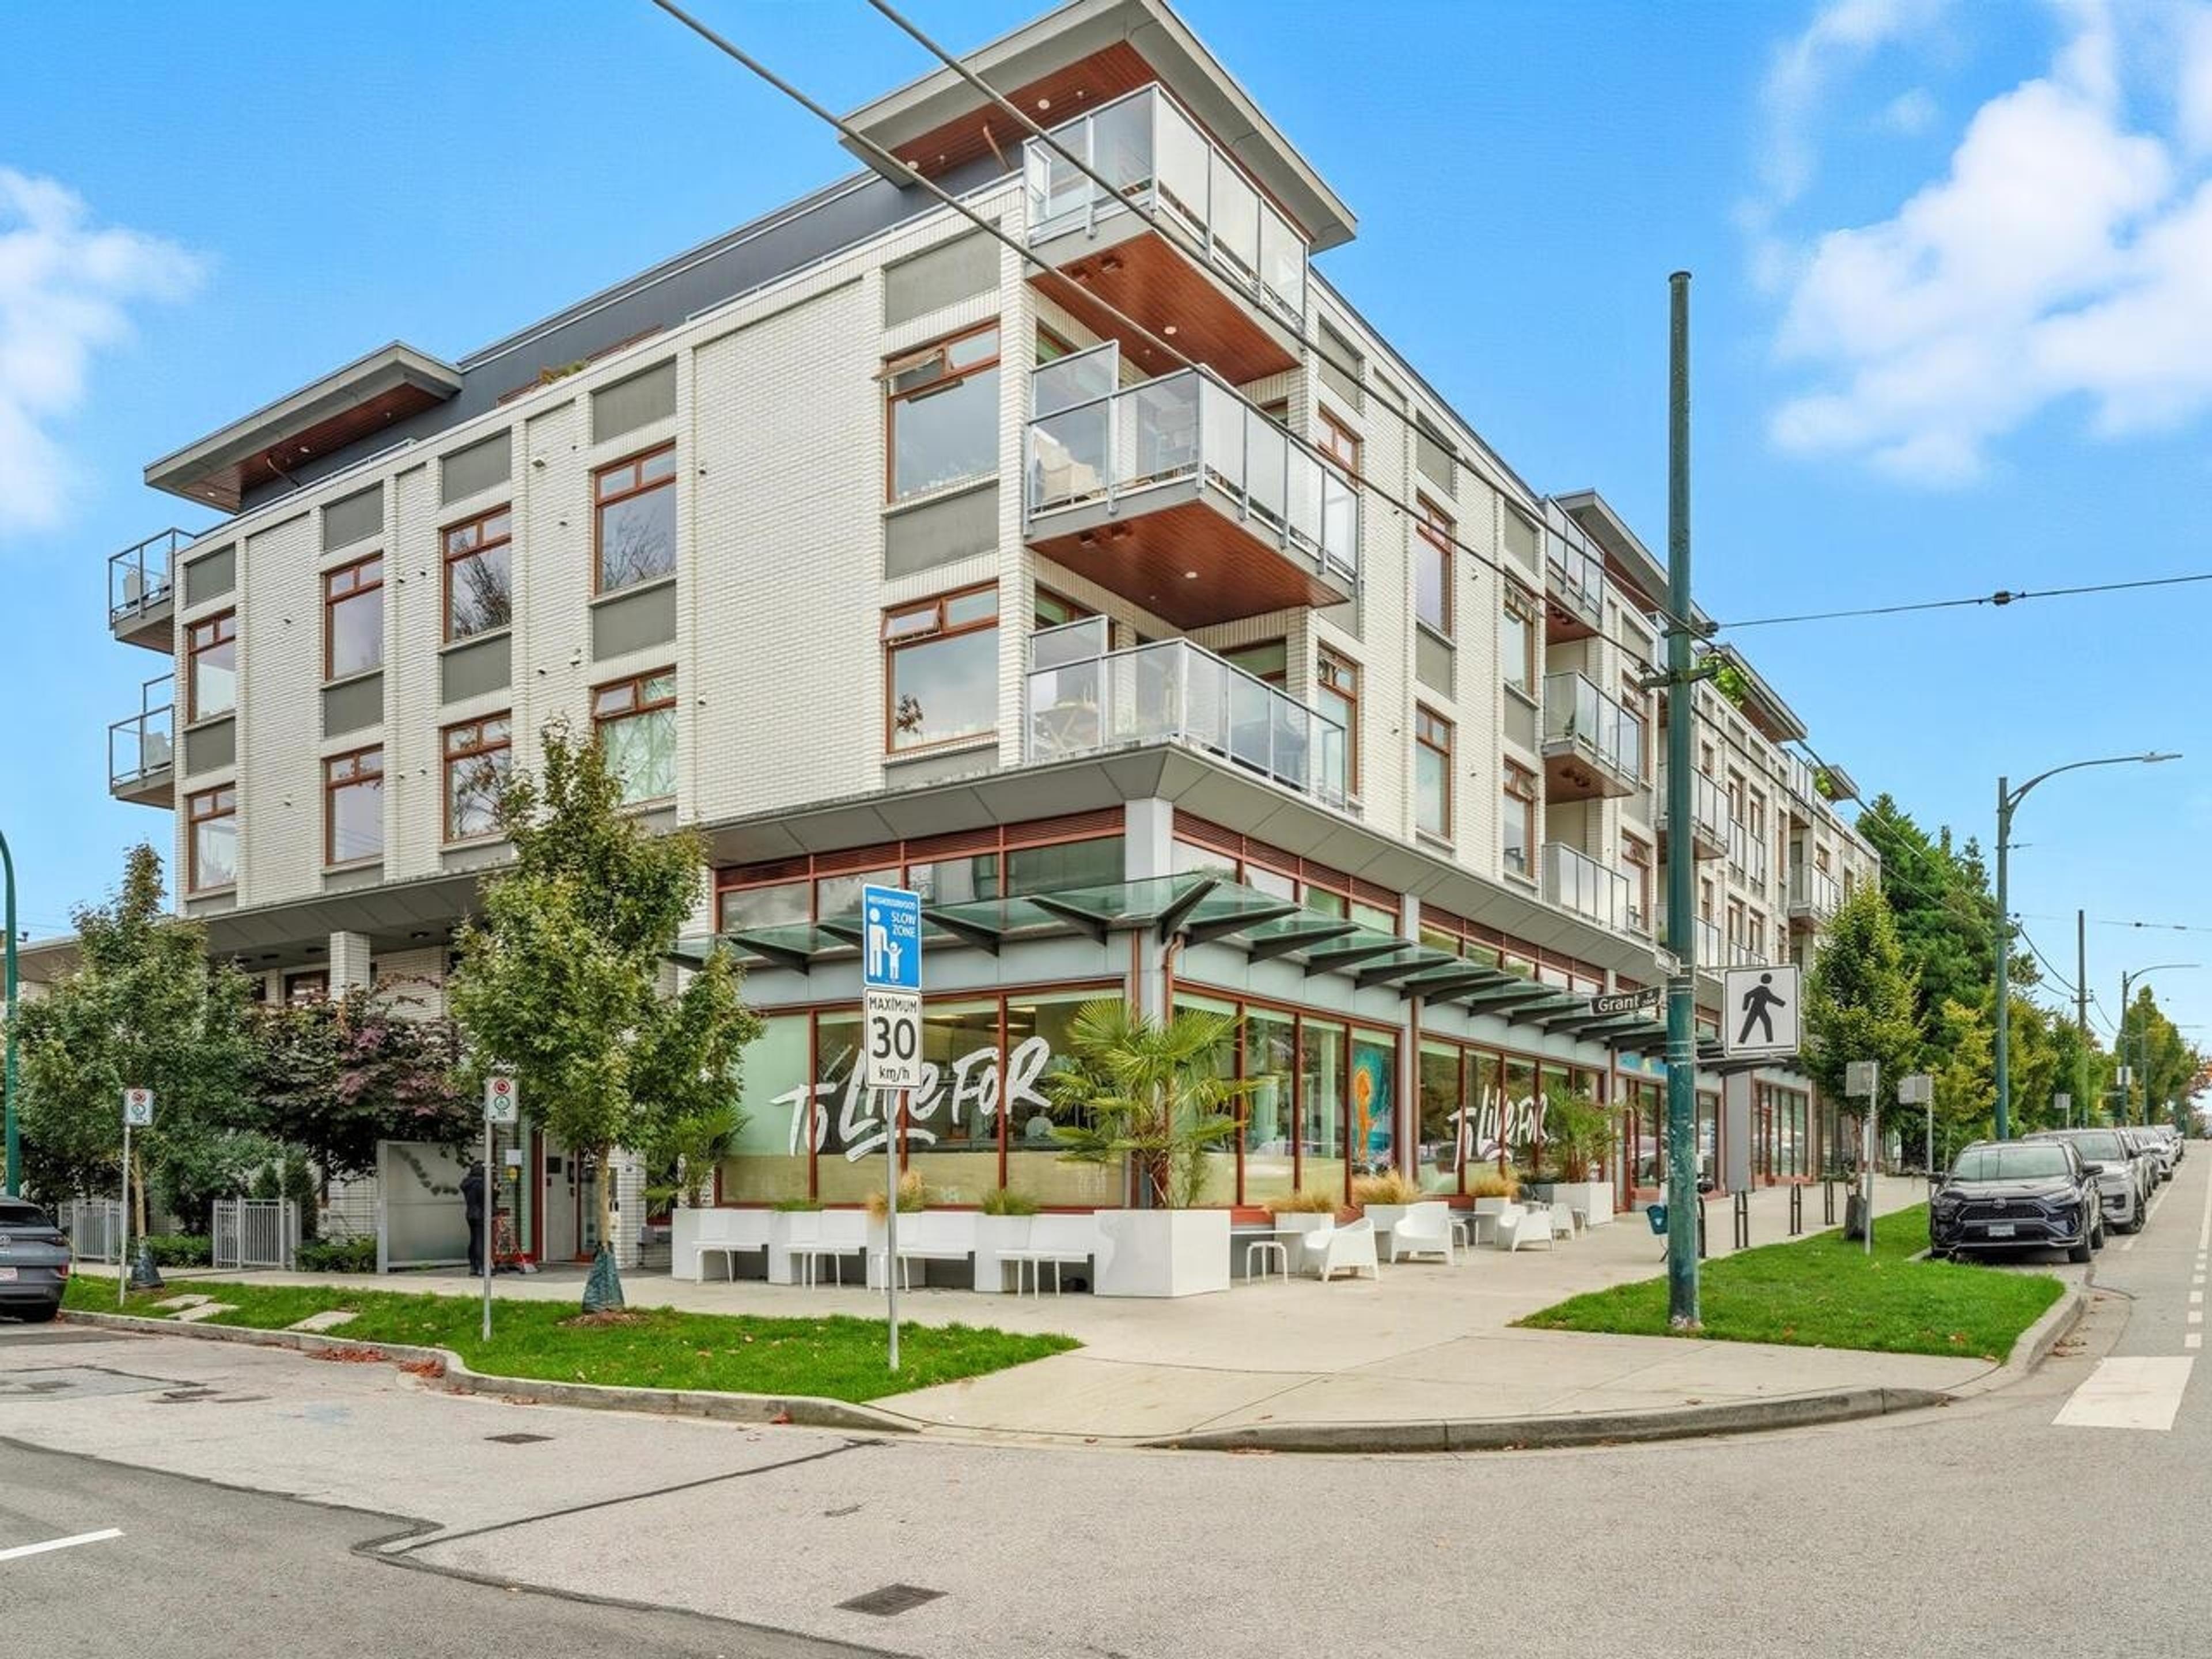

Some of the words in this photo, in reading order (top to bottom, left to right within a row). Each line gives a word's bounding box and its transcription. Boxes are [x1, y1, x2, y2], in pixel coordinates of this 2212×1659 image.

[891, 911, 916, 925] SLOW
[892, 924, 916, 937] ZONE
[869, 996, 916, 1013] MAXIMUM
[1598, 995, 1639, 1012] Grant
[872, 1016, 916, 1060] 30
[879, 1065, 910, 1082] km/h
